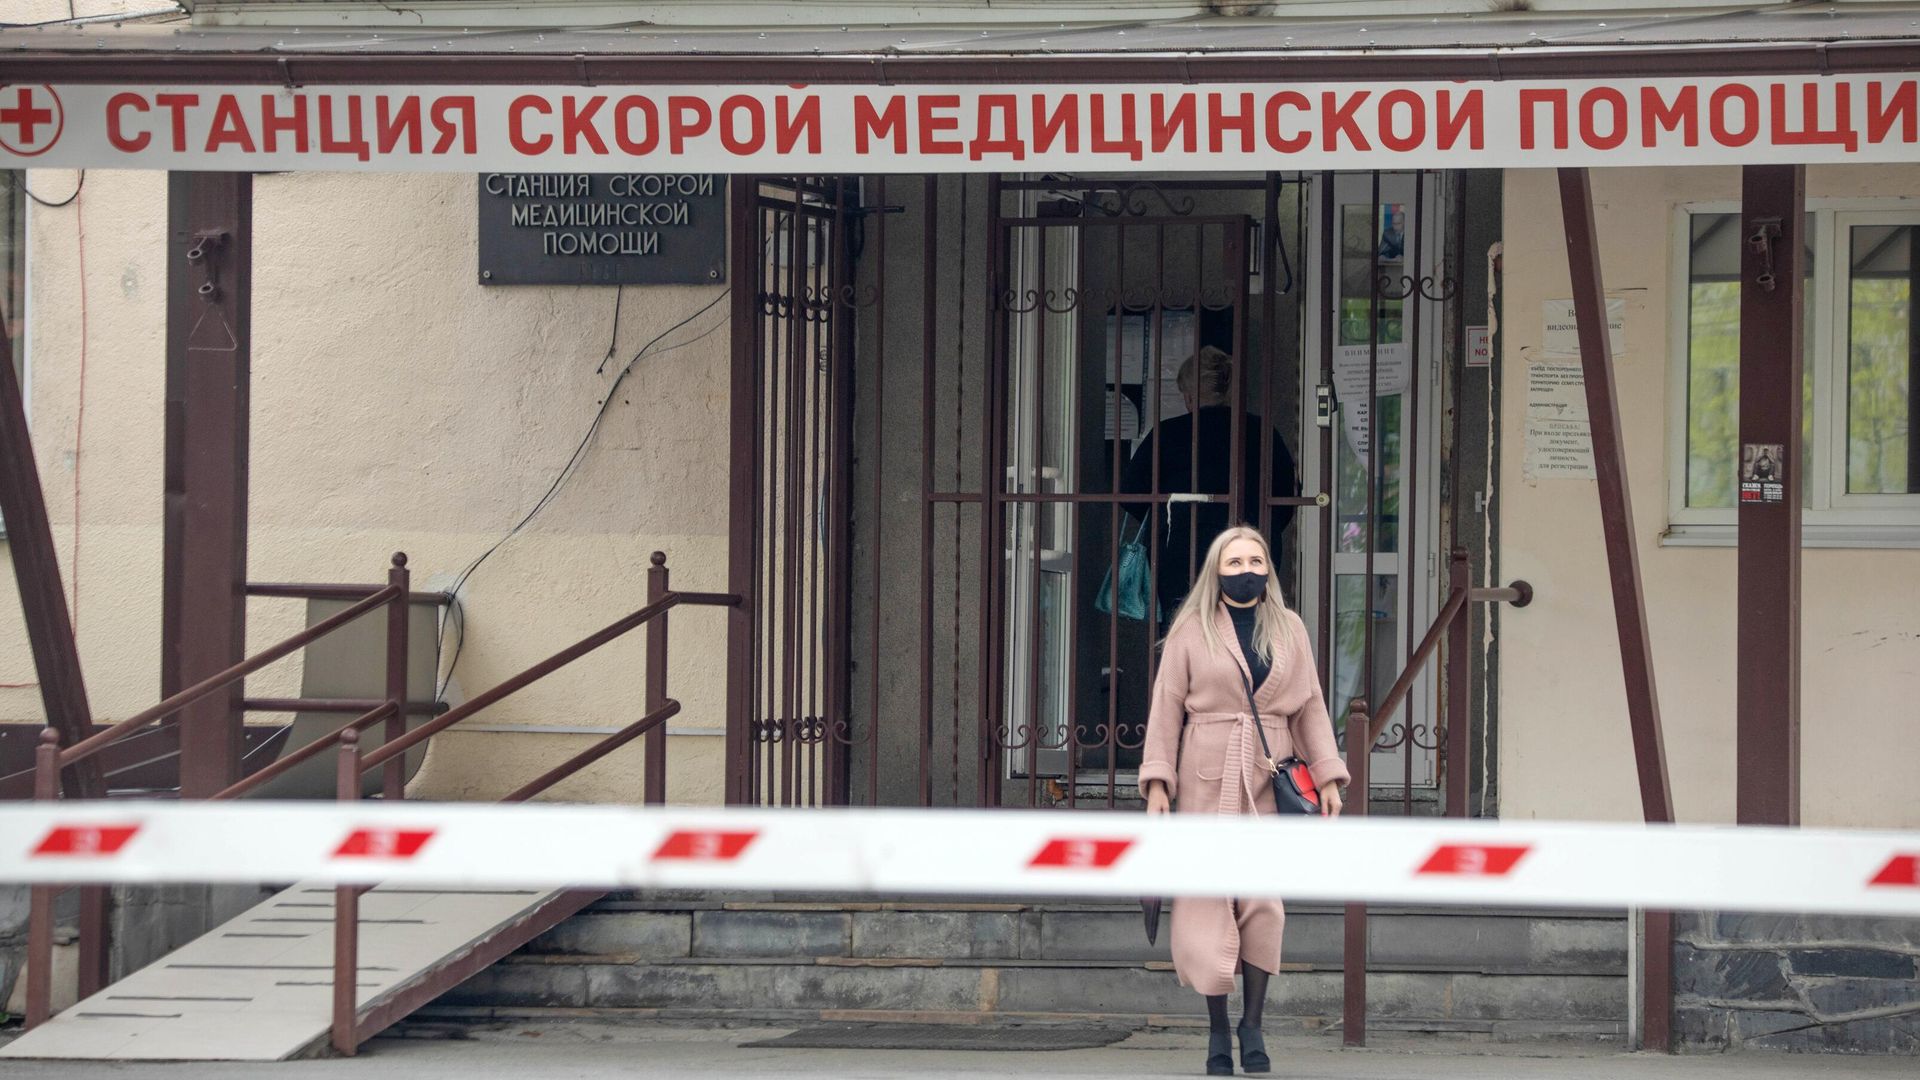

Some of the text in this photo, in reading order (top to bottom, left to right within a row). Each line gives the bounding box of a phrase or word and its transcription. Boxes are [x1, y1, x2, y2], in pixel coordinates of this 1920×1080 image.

[105, 80, 1919, 162] СТАНЦИЯ СКОРОЙ МЕДИЦИНСКОЙ ПОМОЩИ
[485, 173, 591, 198] СТАНЦИЯ
[511, 199, 690, 227] МЕДИЦИНСКОЙ
[543, 231, 660, 255] ПОМОЩИ
[1344, 348, 1395, 357] ВНИМНИЕ
